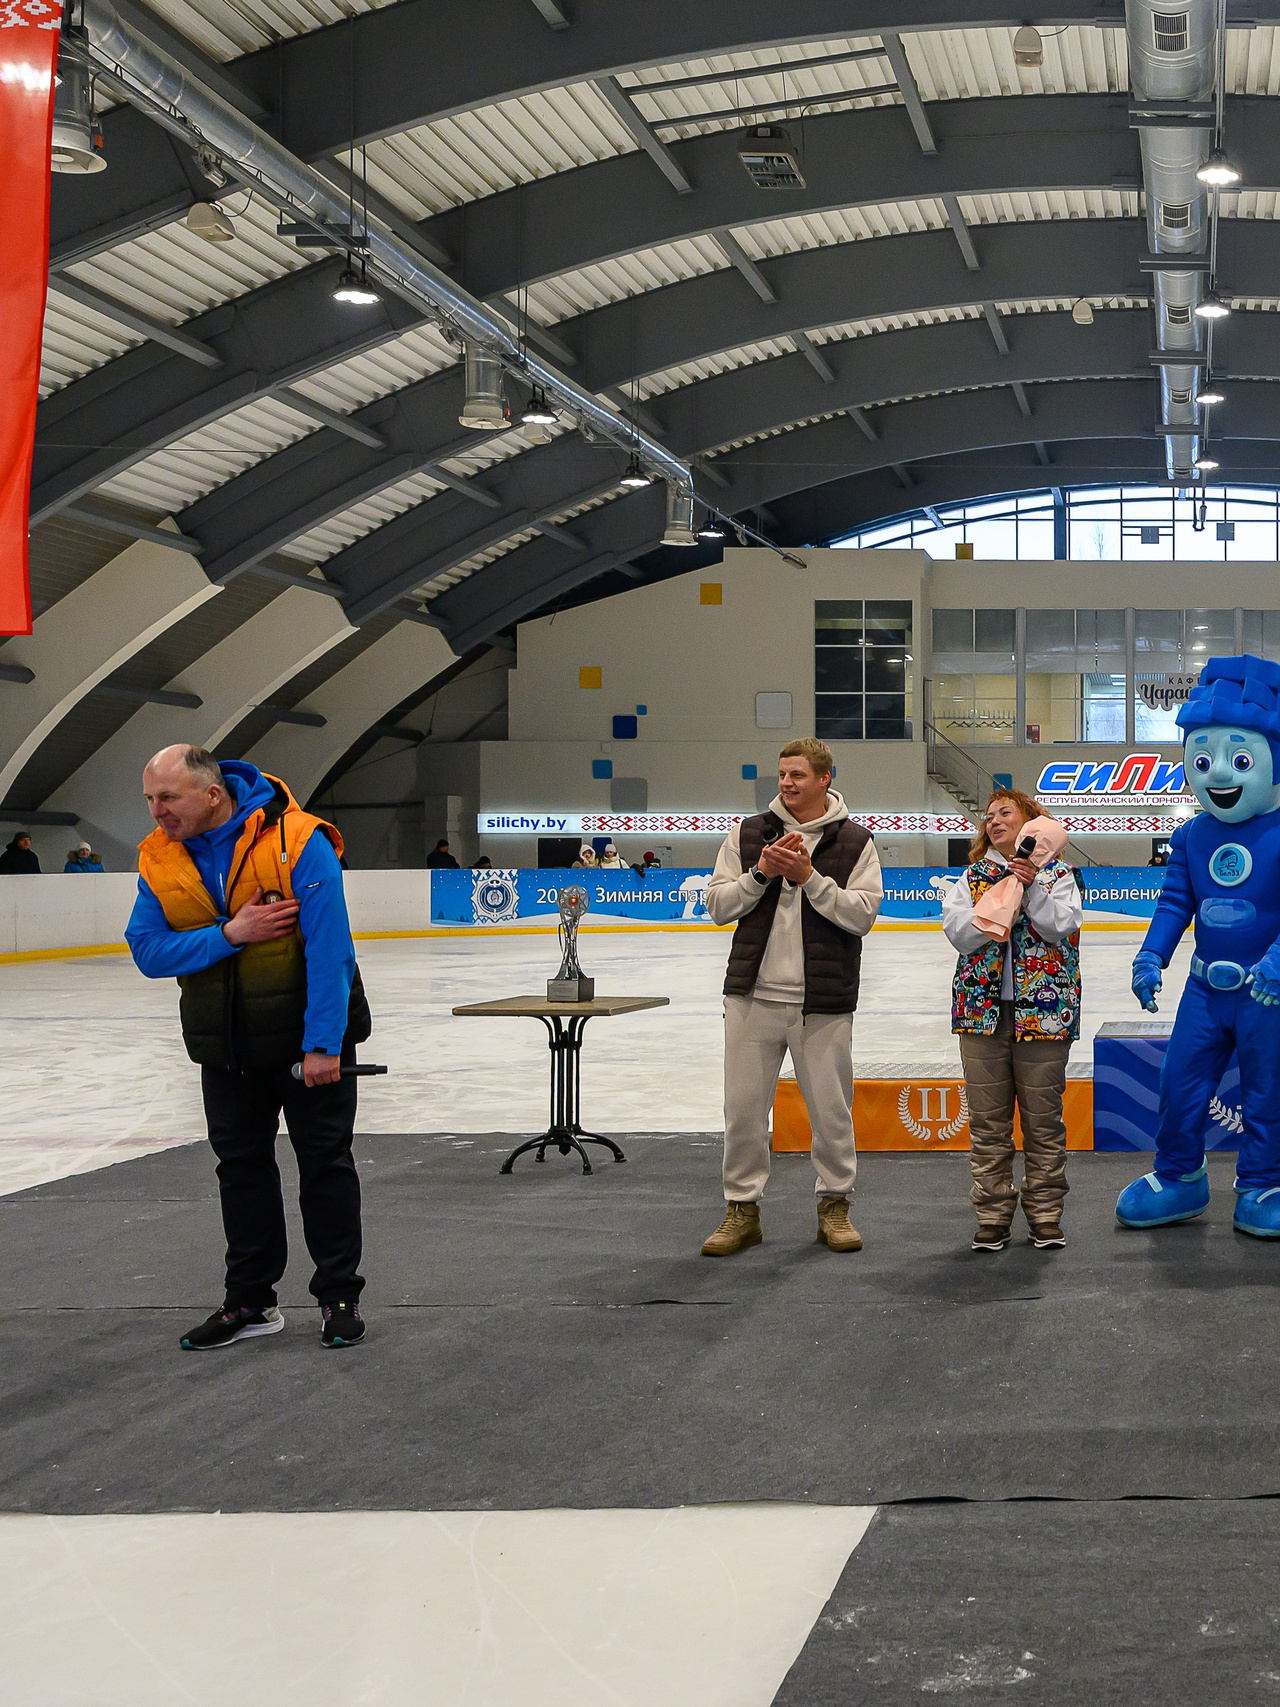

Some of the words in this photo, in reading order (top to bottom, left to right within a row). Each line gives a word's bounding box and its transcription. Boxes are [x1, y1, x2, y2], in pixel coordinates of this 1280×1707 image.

[1036, 795, 1144, 804] РЕСПУБЛИКАНСКИЙ
[1146, 796, 1200, 804] ГОРНОЛЫ
[487, 817, 566, 830] silichy.by
[595, 887, 663, 903] Зимняя
[917, 1087, 952, 1122] II
